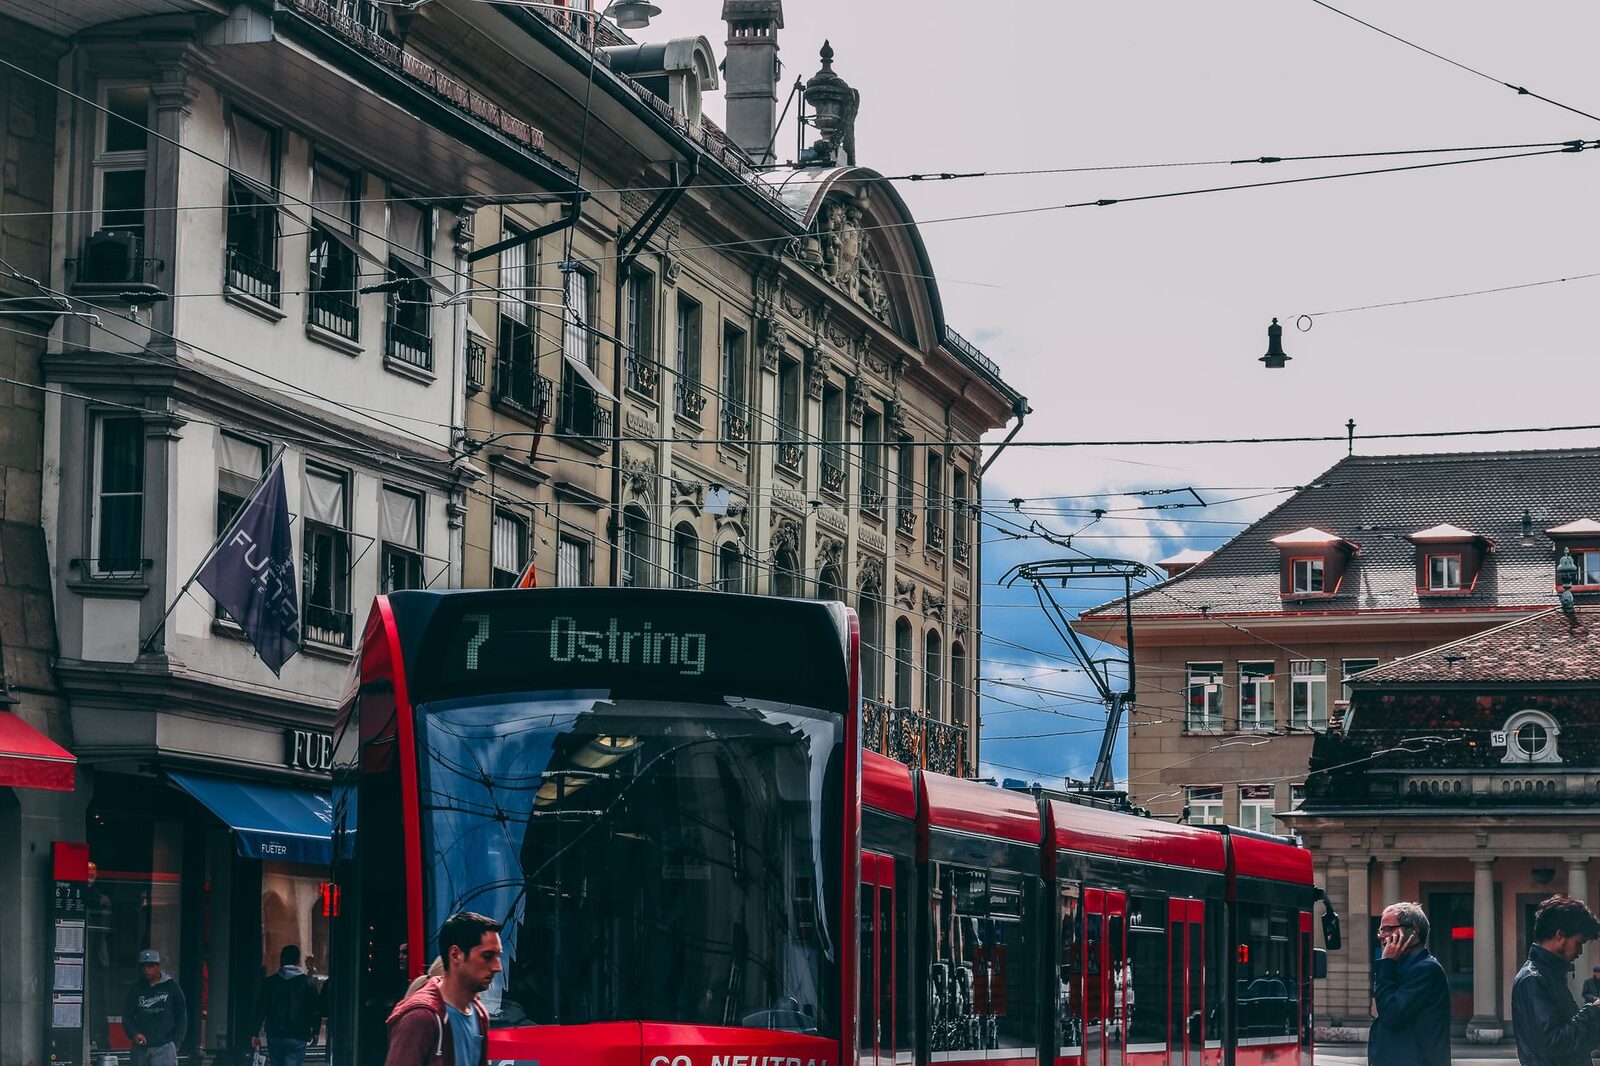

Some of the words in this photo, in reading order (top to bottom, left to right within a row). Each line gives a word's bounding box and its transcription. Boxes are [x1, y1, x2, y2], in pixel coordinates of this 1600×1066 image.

[462, 614, 490, 670] 7
[550, 616, 706, 675] Ostring
[1493, 734, 1504, 743] 15
[292, 730, 332, 770] FUE
[261, 843, 287, 855] FUETER
[56, 888, 61, 897] 6
[66, 888, 71, 897] 7
